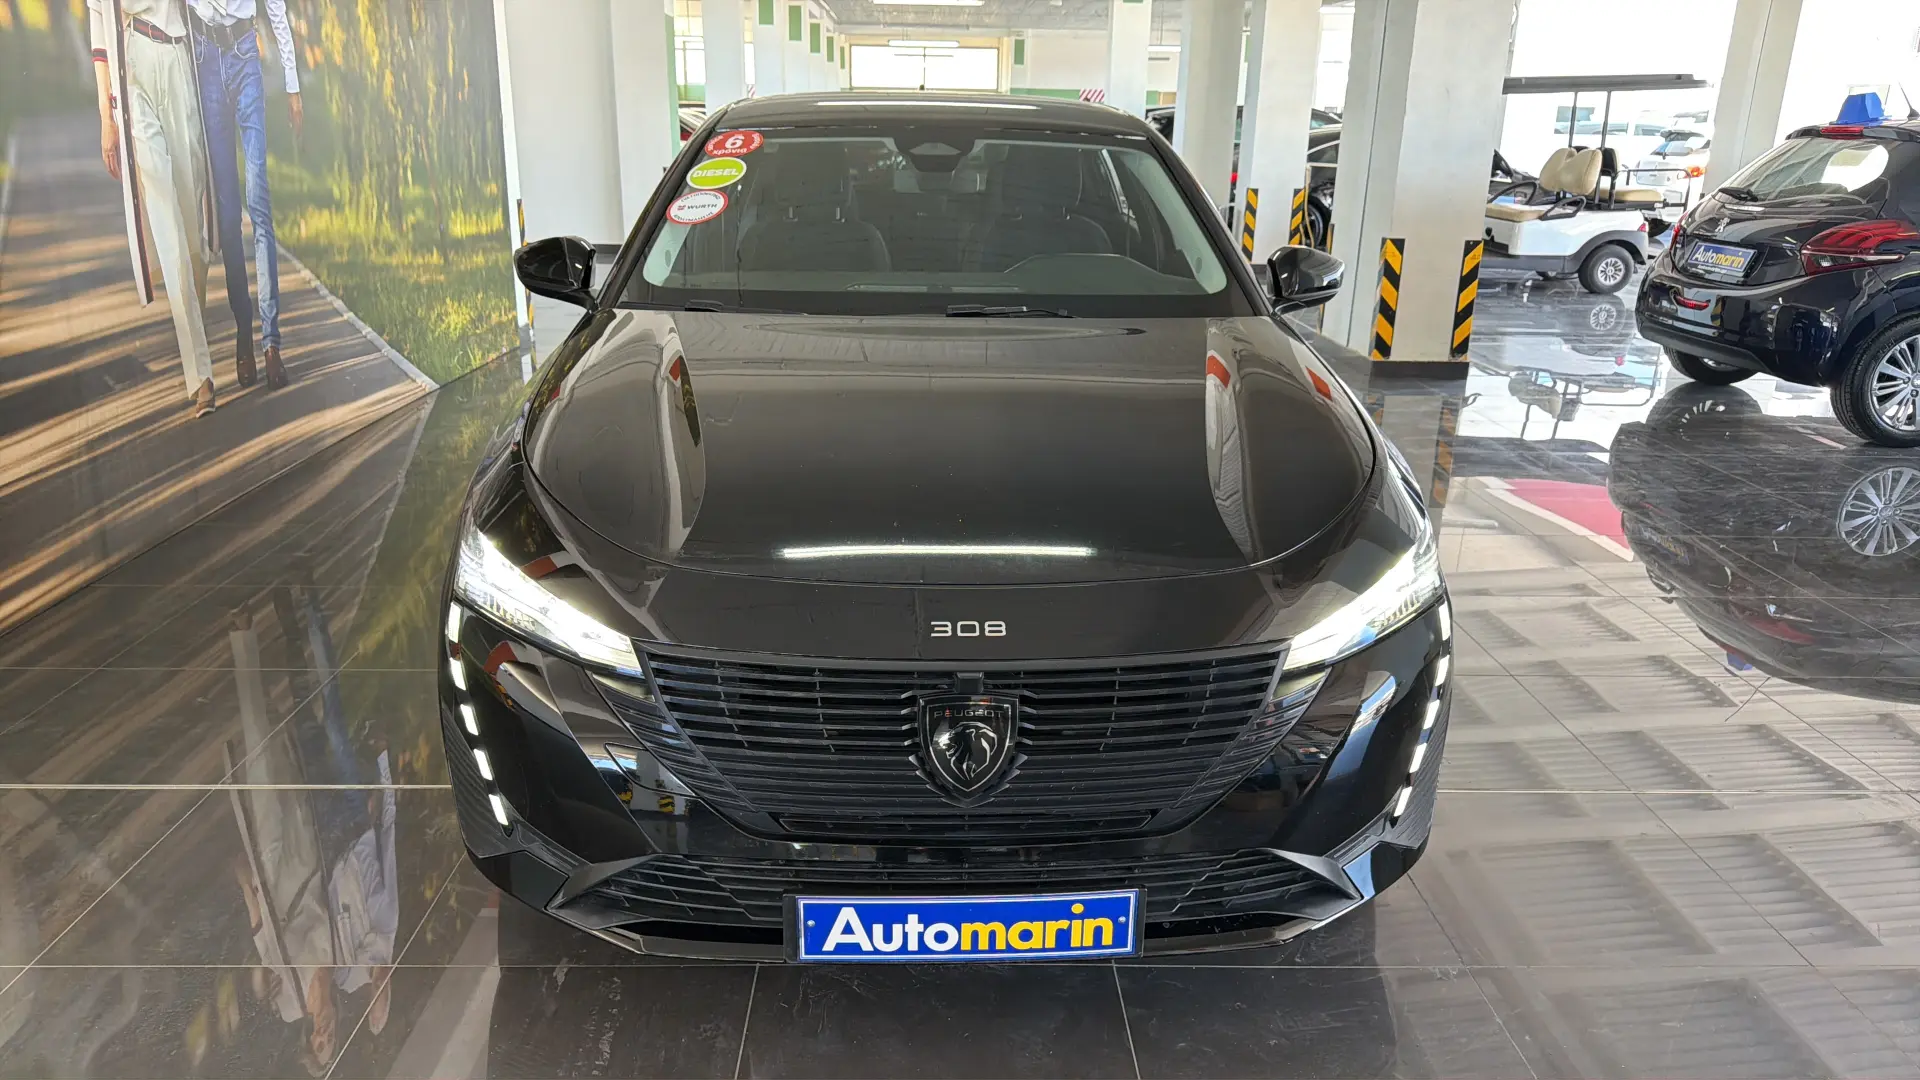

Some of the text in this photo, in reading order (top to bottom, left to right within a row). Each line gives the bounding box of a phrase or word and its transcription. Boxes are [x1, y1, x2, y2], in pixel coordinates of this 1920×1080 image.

[725, 135, 745, 149] 6
[692, 168, 739, 178] DIESEL
[1691, 245, 1745, 268] Automarin
[930, 621, 1007, 637] 308
[934, 709, 1004, 719] PEUGEOT
[821, 903, 1114, 952] Automarin
